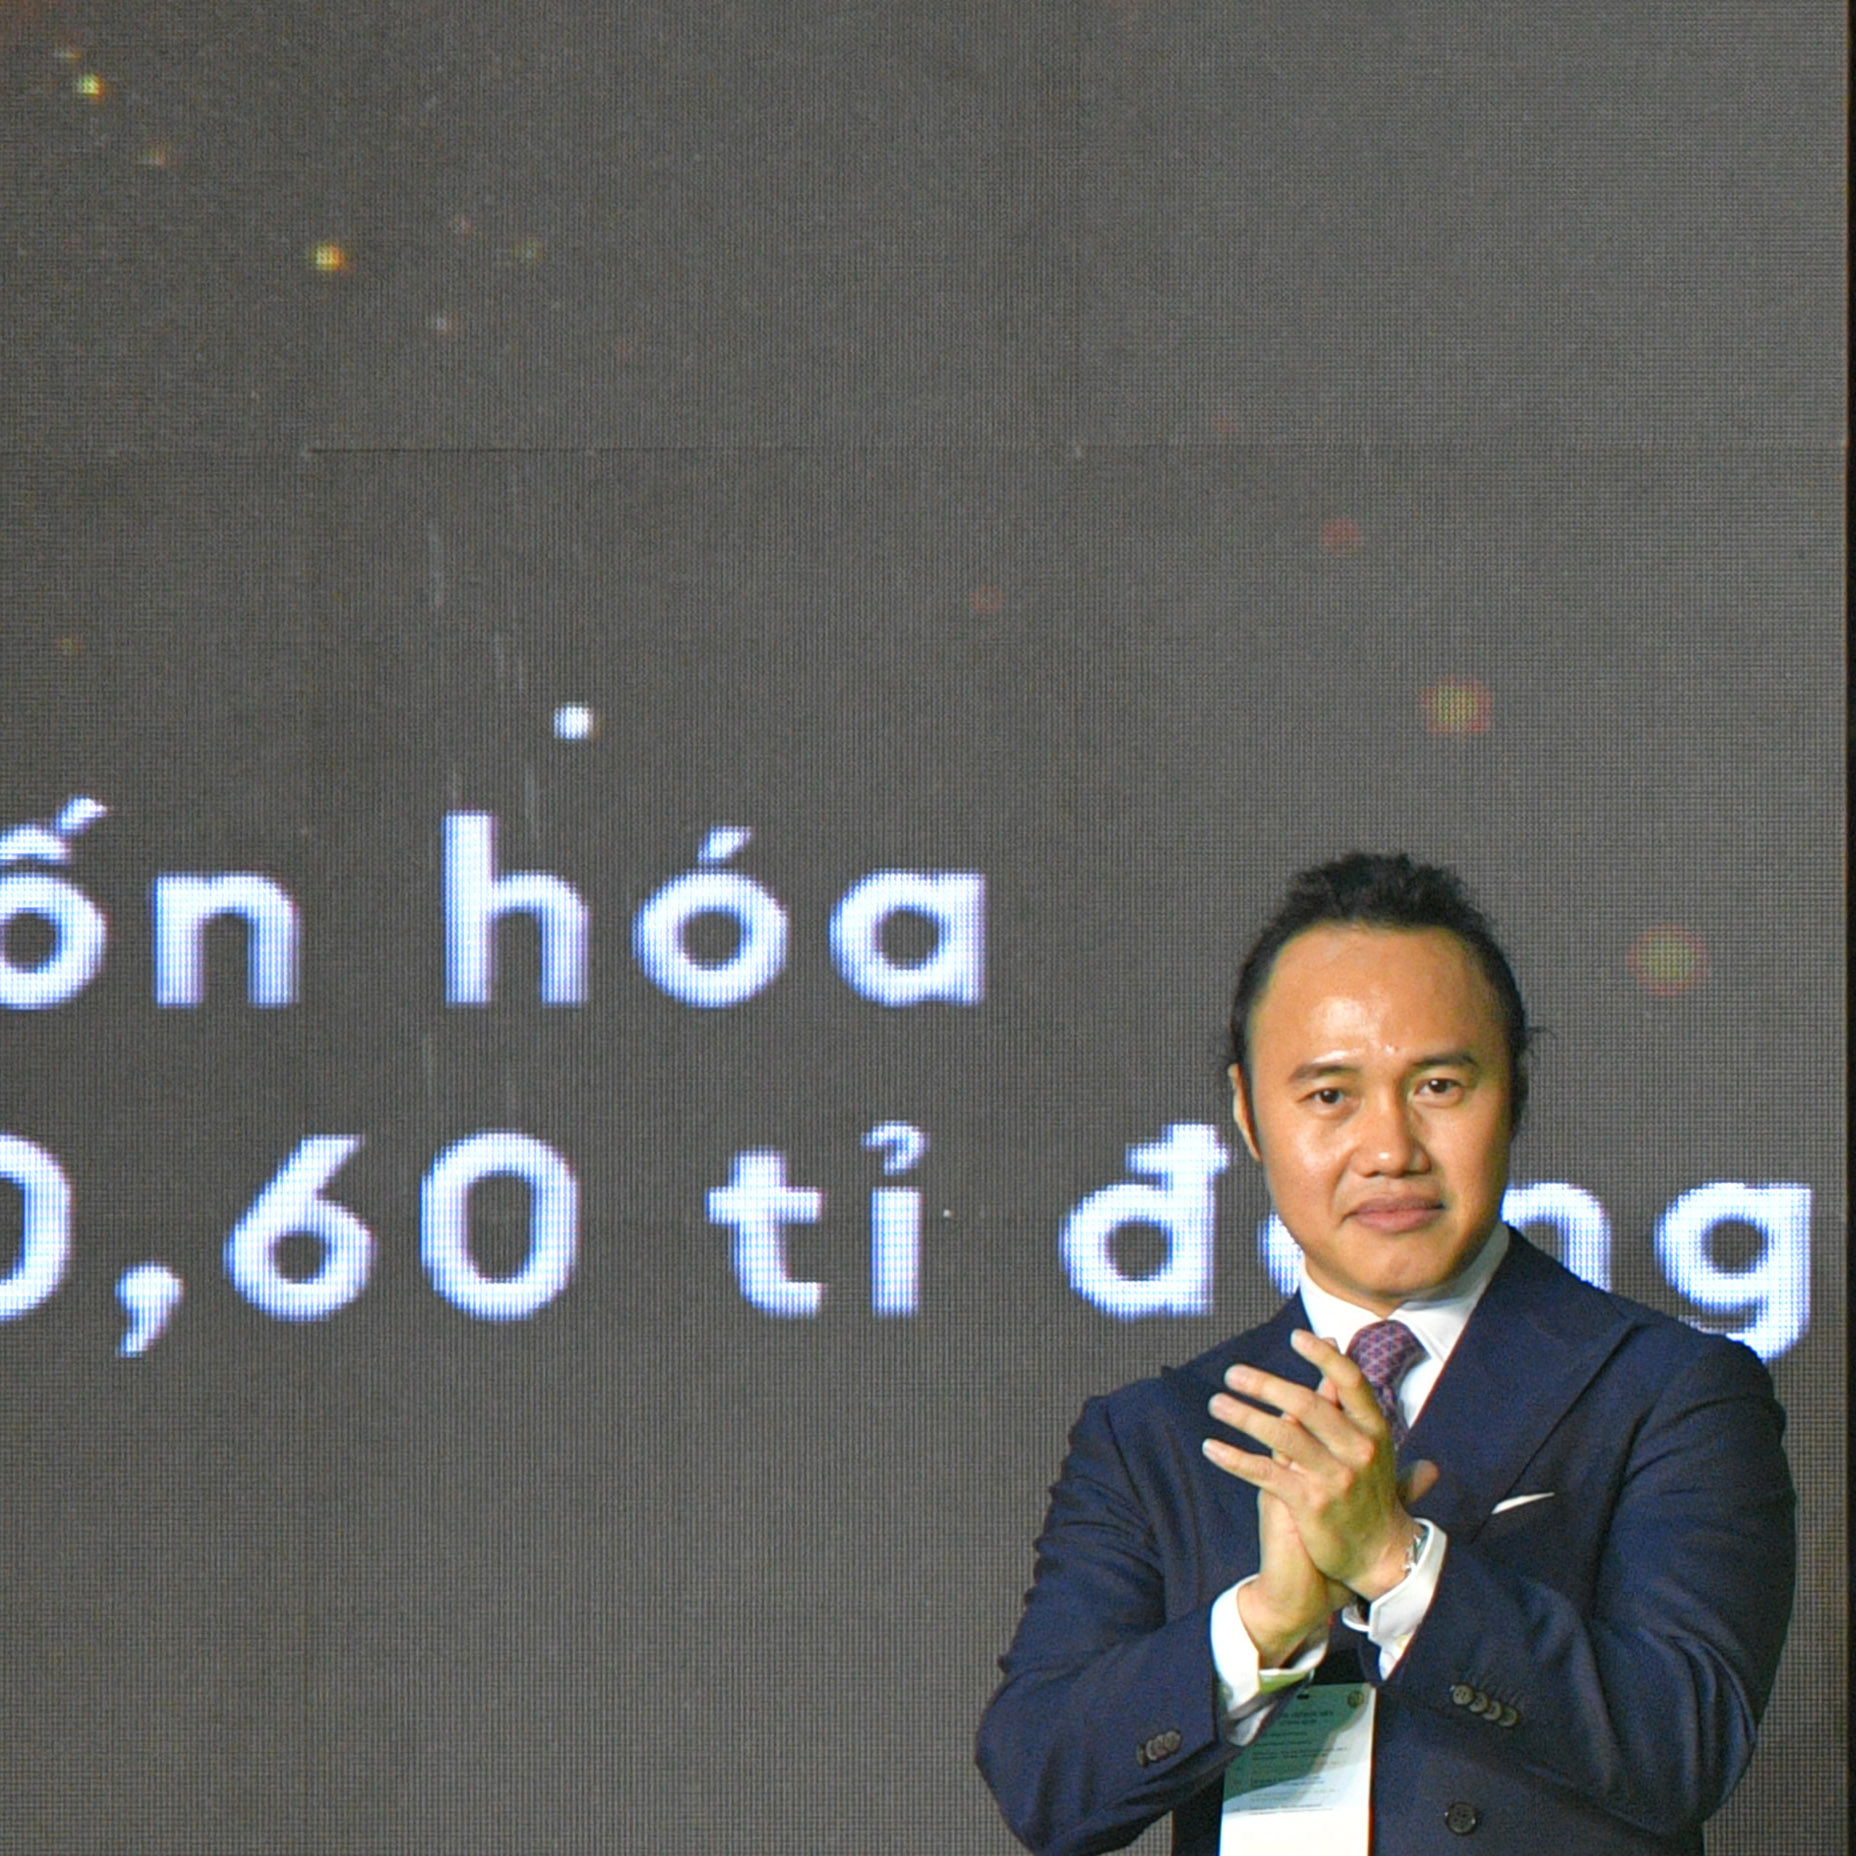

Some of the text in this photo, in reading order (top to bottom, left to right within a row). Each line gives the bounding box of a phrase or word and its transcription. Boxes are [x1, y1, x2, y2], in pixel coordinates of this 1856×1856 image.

[443, 810, 987, 1007] hóa
[706, 1120, 928, 1316] tỉ
[1059, 1123, 1811, 1362] đng
